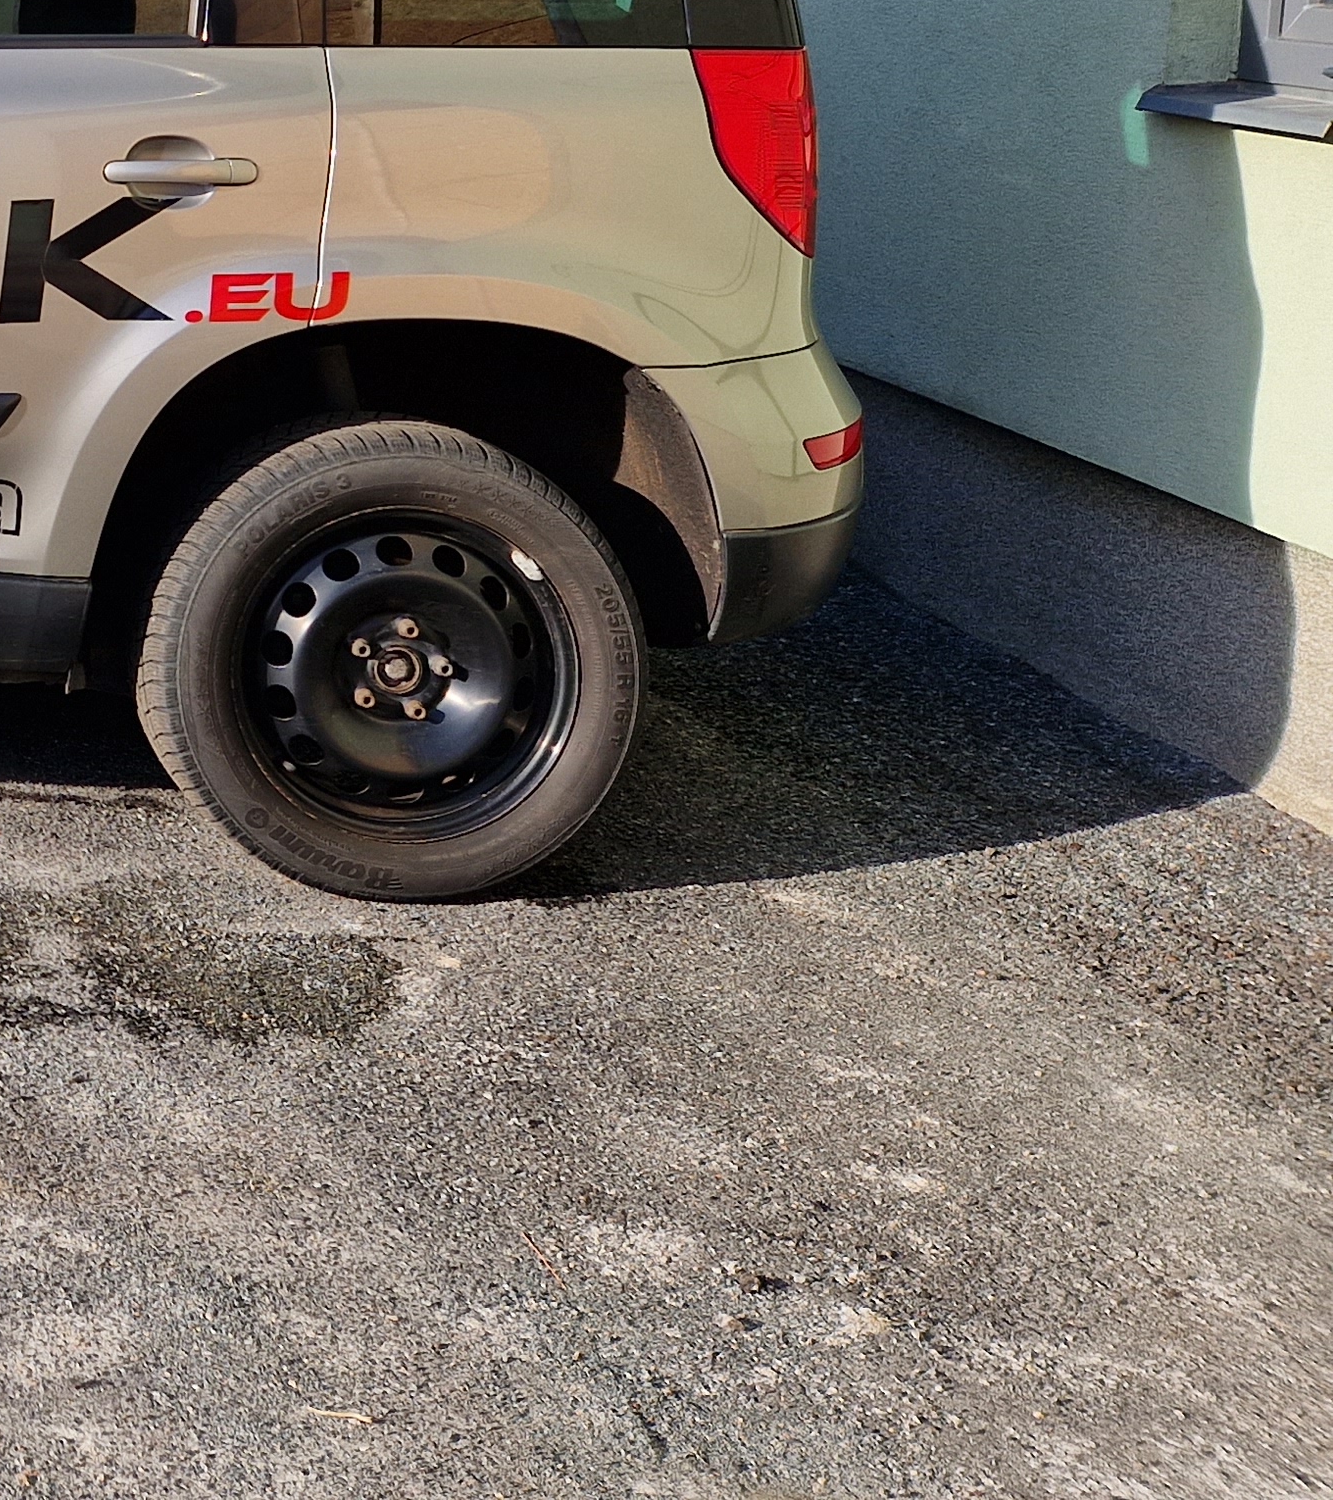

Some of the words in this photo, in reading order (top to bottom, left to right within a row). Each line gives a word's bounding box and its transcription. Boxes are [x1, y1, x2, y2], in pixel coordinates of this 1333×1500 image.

[234, 477, 330, 557] POLARIS
[336, 472, 353, 490] 3
[594, 582, 634, 667] 205/55
[612, 698, 632, 725] 16
